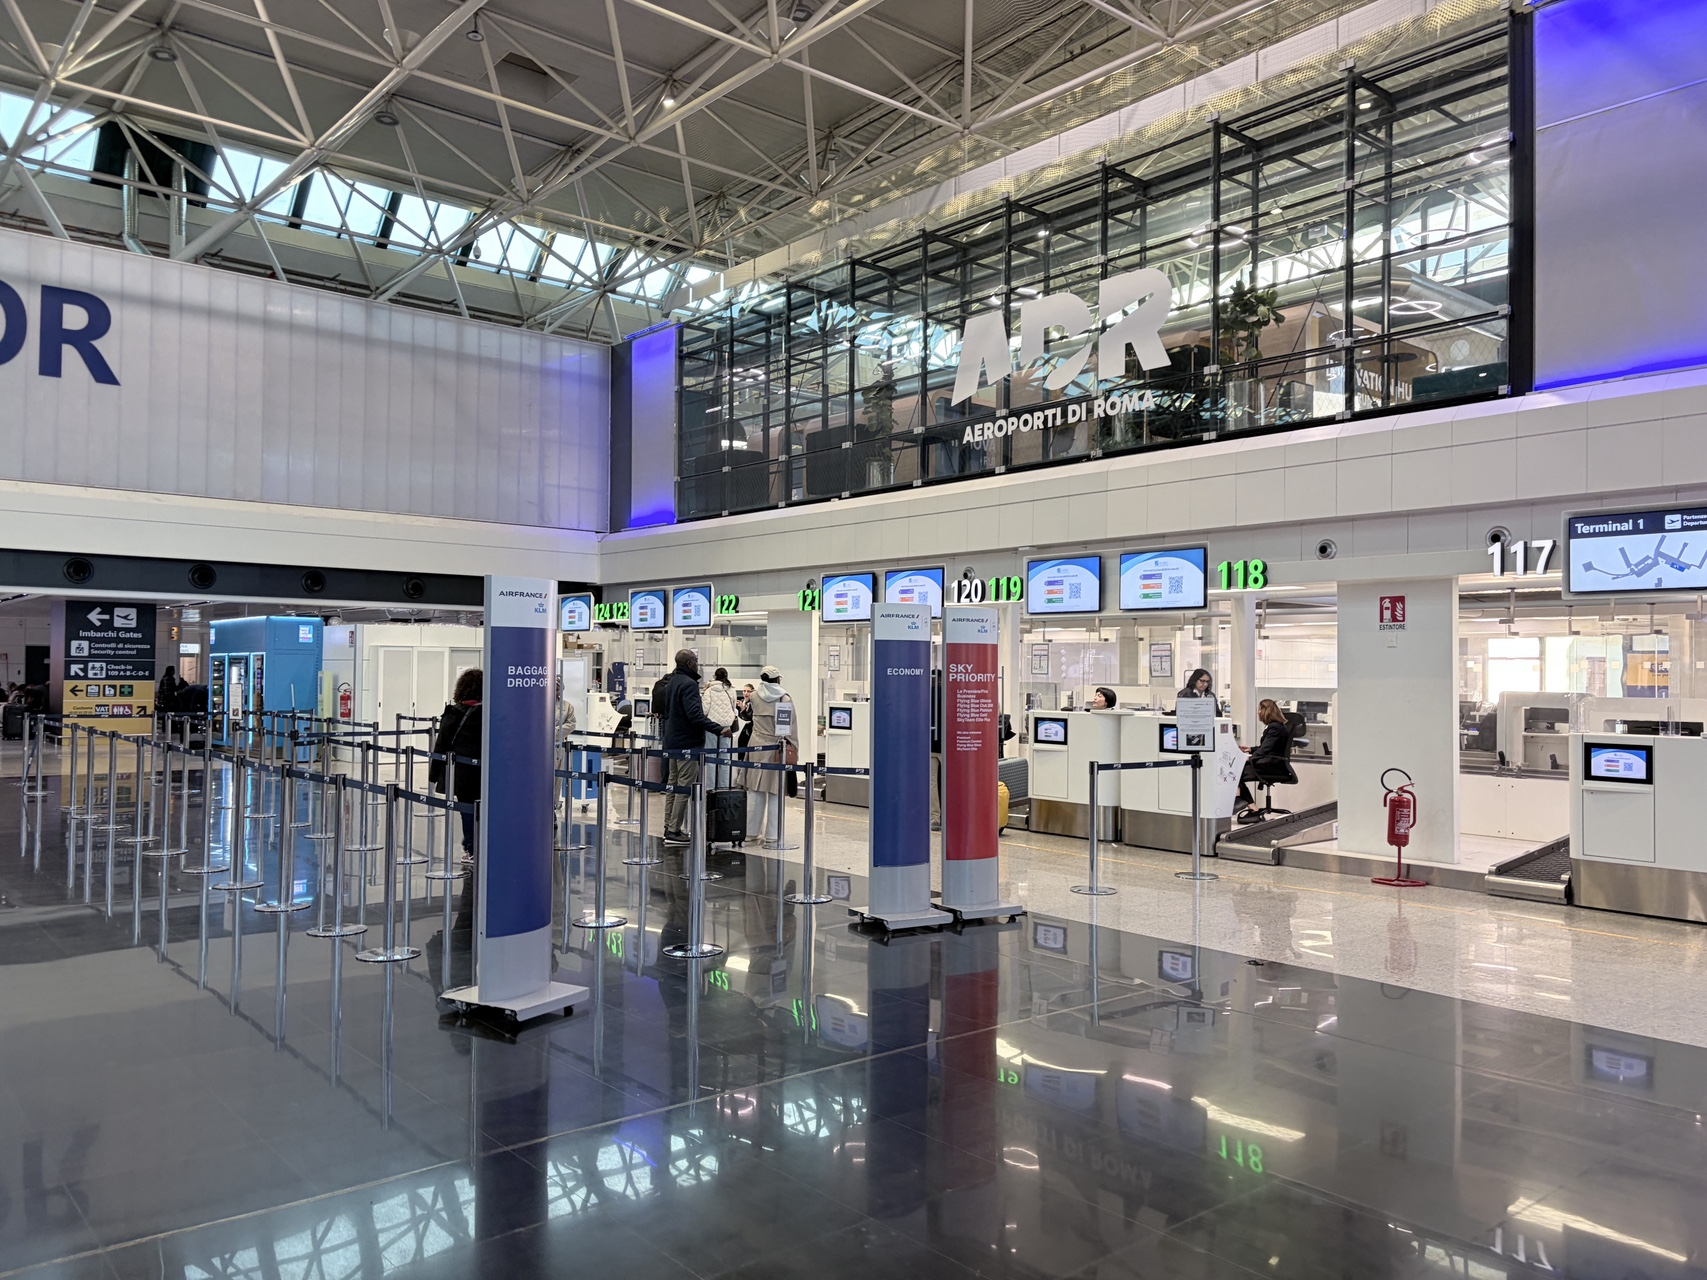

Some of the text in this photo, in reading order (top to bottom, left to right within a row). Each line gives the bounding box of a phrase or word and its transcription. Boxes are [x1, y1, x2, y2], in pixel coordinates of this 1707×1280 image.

[951, 267, 1172, 407] ADR
[1398, 380, 1412, 401] HU
[963, 392, 1156, 444] AEROPORTI DI ROMA
[1575, 518, 1644, 534] Terminal 1
[1487, 540, 1556, 577] 117
[1217, 559, 1267, 590] 118
[951, 578, 985, 603] 120
[988, 576, 1023, 602] 119
[716, 594, 738, 614] 122
[798, 589, 820, 610] 121
[594, 603, 610, 620] 124
[612, 602, 629, 620] 123
[79, 630, 143, 639] Imbarchi Gates
[508, 665, 549, 675] BAGGAG
[887, 667, 925, 676] ECONOMY
[949, 663, 973, 672] SKY
[507, 678, 550, 687] DROP-OF
[949, 673, 996, 682] PRIORITY
